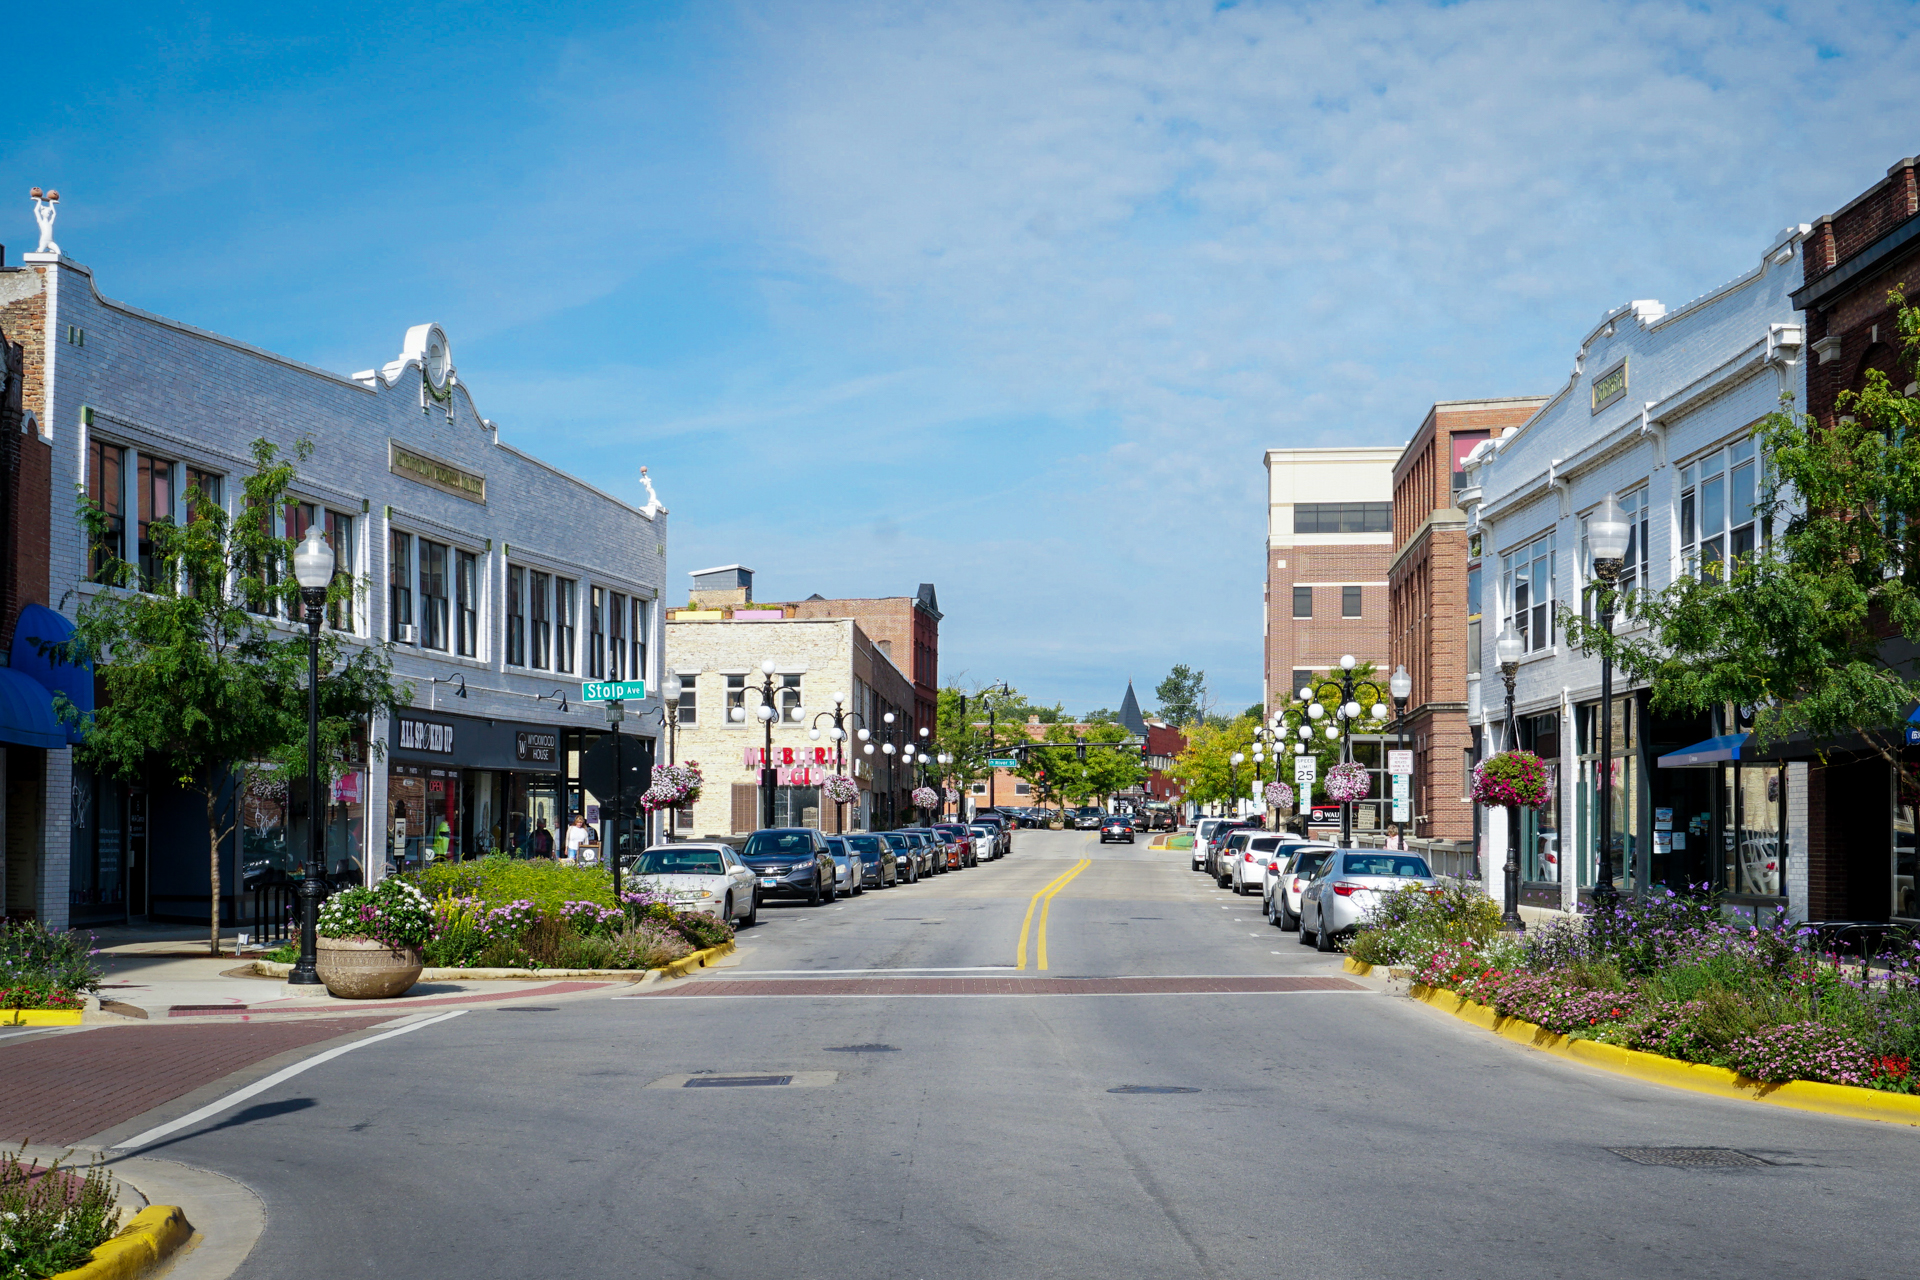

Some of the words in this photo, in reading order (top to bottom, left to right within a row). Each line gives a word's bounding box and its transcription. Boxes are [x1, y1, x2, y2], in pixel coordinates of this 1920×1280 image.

[588, 683, 624, 699] Stolp
[400, 720, 415, 748] ALL
[414, 721, 444, 752] SPOKED
[444, 725, 454, 753] UP
[532, 749, 549, 760] HOUSE
[756, 767, 824, 786] SRGIO
[1297, 770, 1314, 781] 25
[429, 780, 444, 792] OPEN
